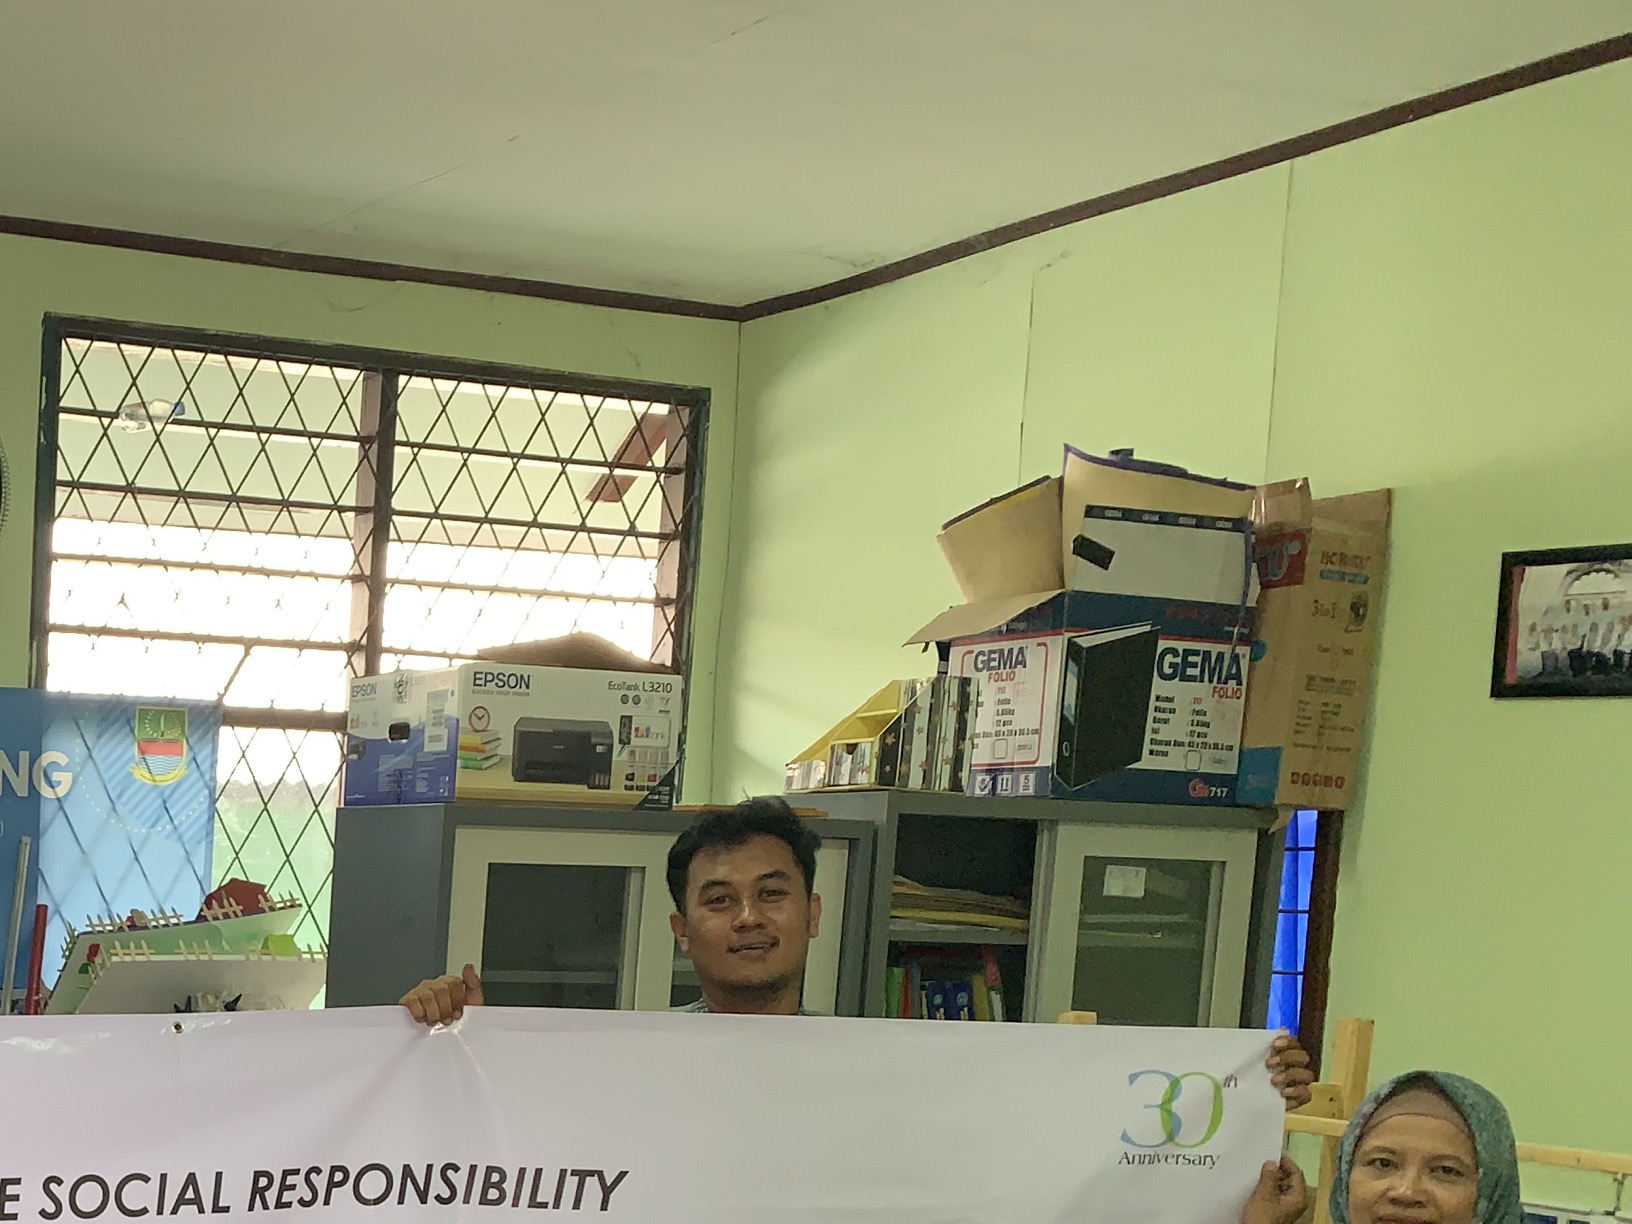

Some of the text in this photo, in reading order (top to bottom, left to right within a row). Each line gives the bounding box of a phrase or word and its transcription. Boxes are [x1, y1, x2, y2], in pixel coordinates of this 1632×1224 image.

[974, 647, 1027, 673] GEMA
[1156, 647, 1243, 687] GEMA
[473, 671, 530, 690] EPSON
[988, 670, 1016, 684] FOLIO
[352, 682, 377, 698] EPSON
[608, 681, 672, 693] EcoTank L3210
[1211, 686, 1243, 700] FOLIO
[1209, 786, 1228, 798] 717
[1119, 1151, 1220, 1169] Anniversary
[38, 1171, 231, 1221] SOCIAL
[247, 1162, 630, 1212] RESPONSIBILITY
